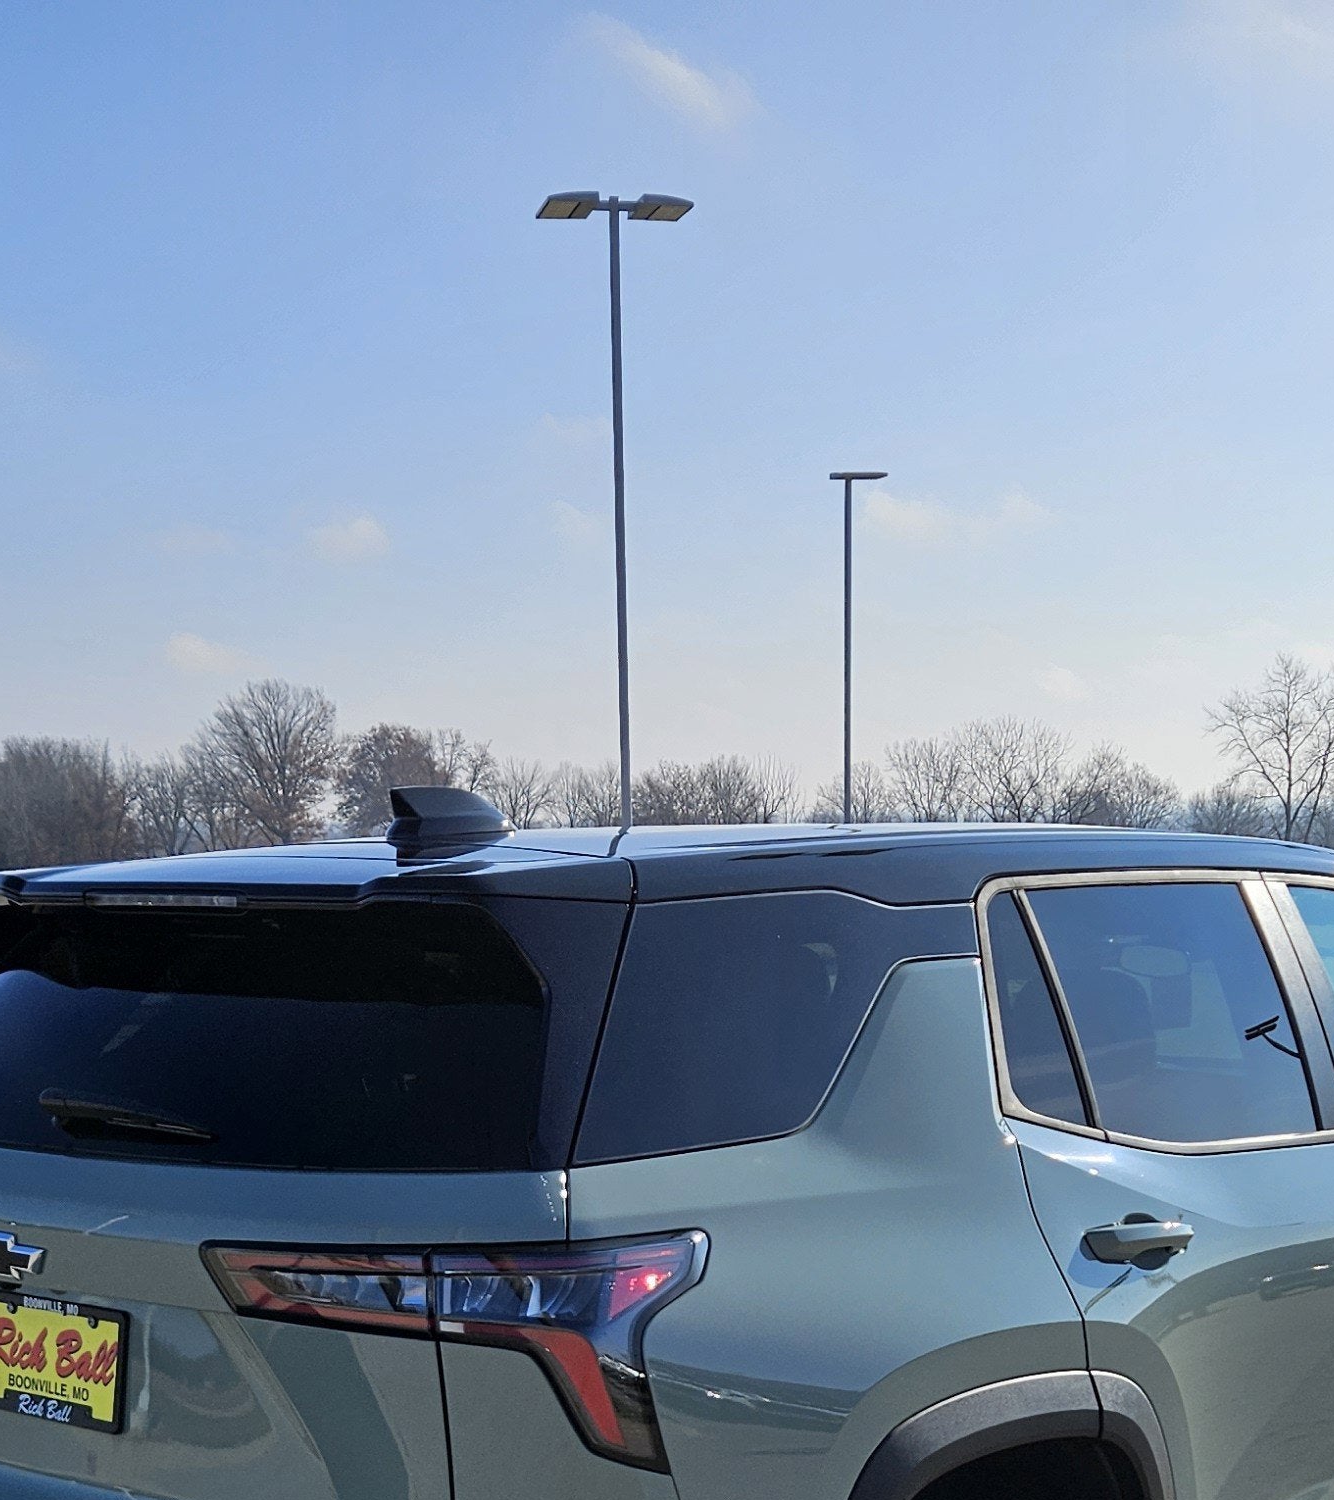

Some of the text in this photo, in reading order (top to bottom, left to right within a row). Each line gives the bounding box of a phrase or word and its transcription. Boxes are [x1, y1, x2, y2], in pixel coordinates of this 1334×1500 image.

[66, 1304, 79, 1316] MO
[55, 1328, 118, 1387] Ball
[8, 1373, 89, 1402] BOONVILLE, MO
[17, 1393, 73, 1423] Rick Ball
